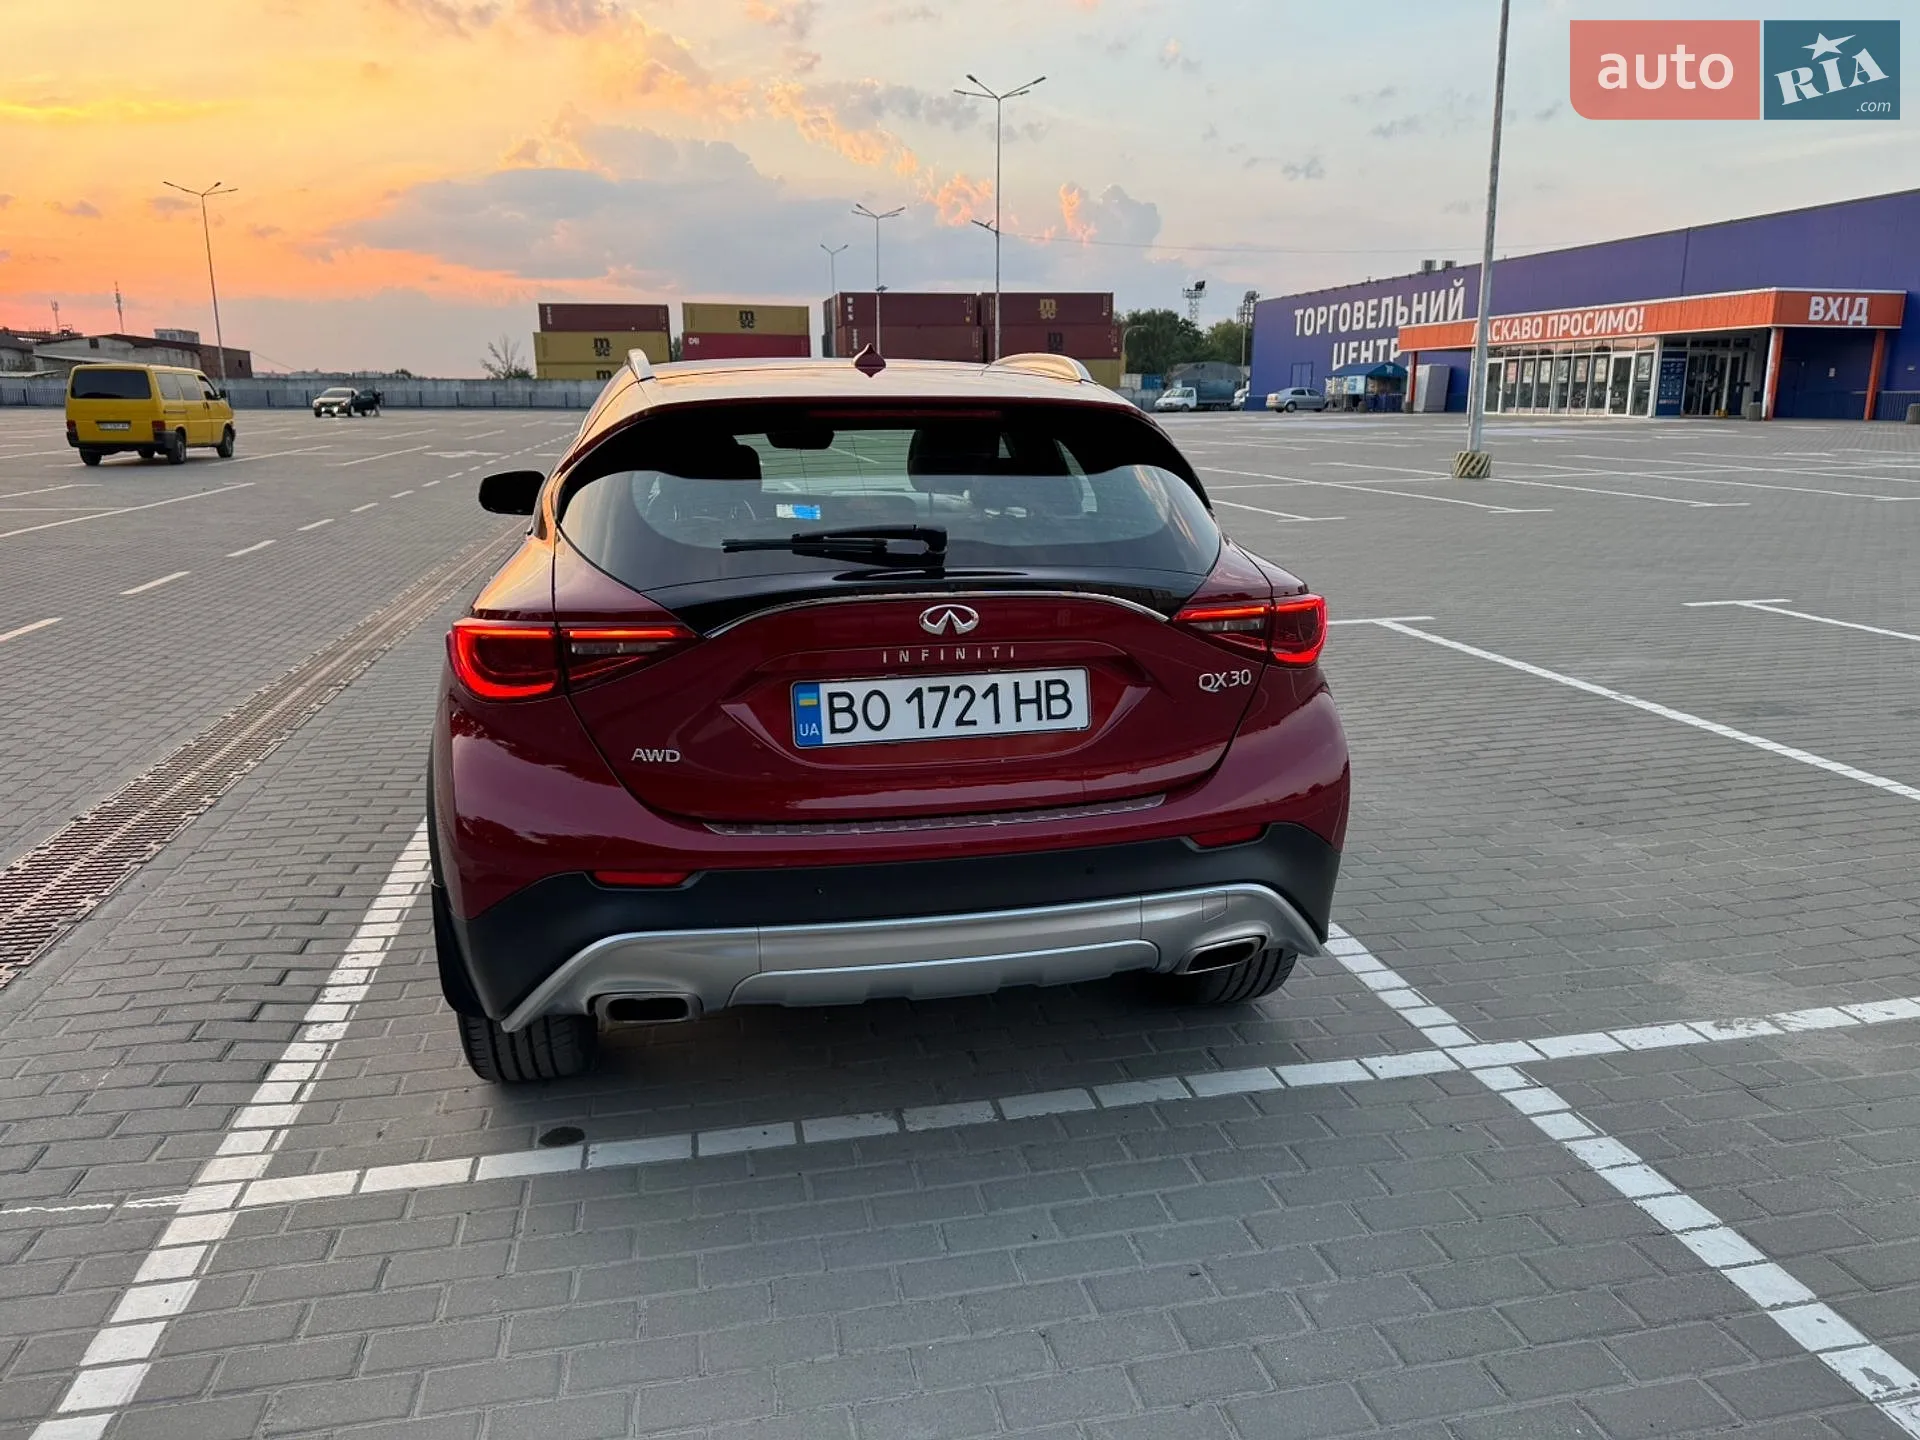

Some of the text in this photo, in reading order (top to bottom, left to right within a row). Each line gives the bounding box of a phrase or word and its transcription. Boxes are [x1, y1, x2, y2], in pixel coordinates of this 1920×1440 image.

[1294, 278, 1465, 337] ТОРГОВЕЛЬНИЙ
[1808, 295, 1869, 326] ВХІД
[1546, 306, 1645, 338] ПРОСИМО!
[882, 645, 1017, 664] INFINITI
[1198, 669, 1253, 692] QX30
[827, 678, 1073, 734] BO 1721 HB
[799, 722, 820, 737] UA
[631, 746, 681, 763] AWD
